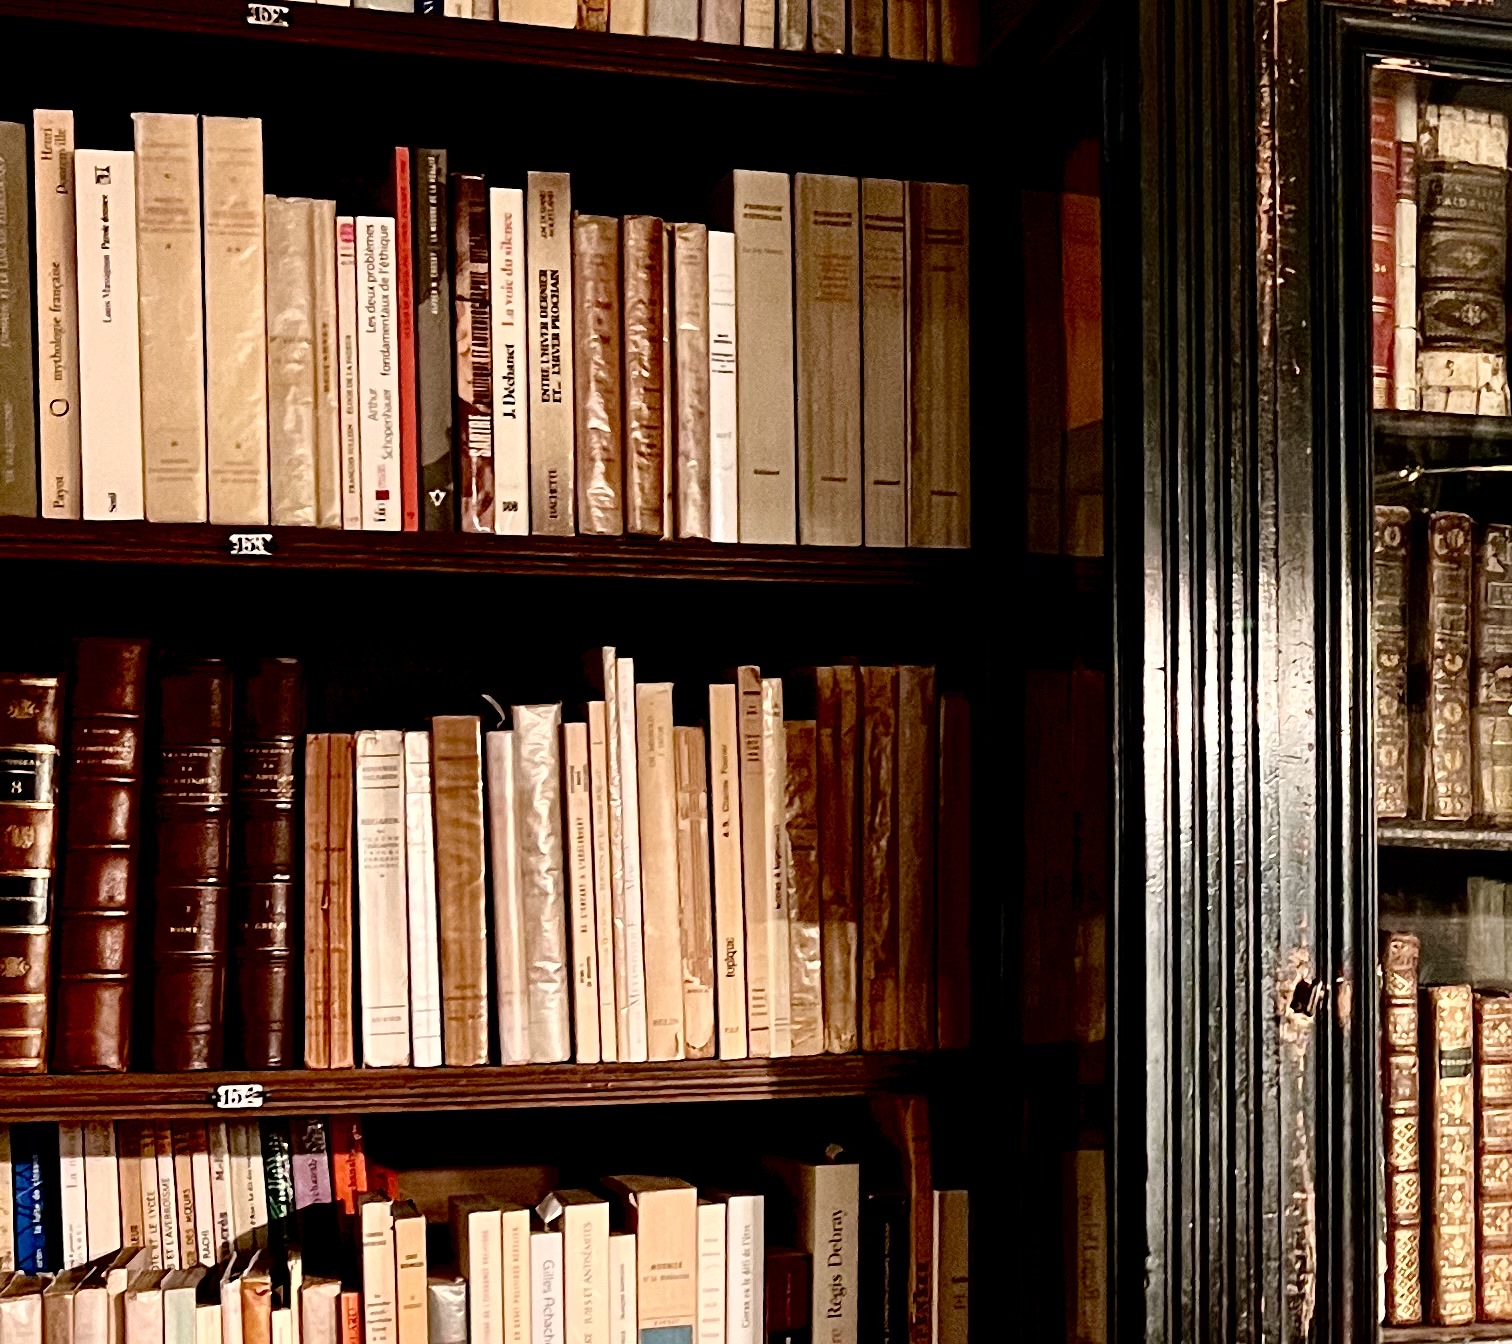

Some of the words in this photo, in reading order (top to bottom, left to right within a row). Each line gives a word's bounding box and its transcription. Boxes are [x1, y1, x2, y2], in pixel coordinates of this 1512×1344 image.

[40, 128, 53, 161] Henri
[379, 224, 392, 275] l'éthique
[500, 212, 513, 257] silence
[364, 224, 378, 283] problèmes
[500, 259, 513, 277] du
[49, 261, 62, 313] française
[365, 286, 377, 313] deux
[379, 276, 391, 292] de
[501, 279, 513, 306] voie
[550, 269, 560, 330] PROCHAIN
[365, 314, 377, 334] Les
[379, 293, 391, 376] fondamentaux
[501, 308, 514, 326] La
[50, 316, 63, 382] mythologie
[502, 345, 516, 406] Déchanet
[540, 367, 549, 403] ENTRE
[366, 388, 379, 422] Arthur
[502, 408, 516, 420] J.
[381, 389, 393, 460] Schopenhauer
[53, 475, 66, 510] Payot
[201, 1229, 212, 1260] RACHI
[582, 1222, 593, 1284] ANTISÉMITES
[825, 1209, 847, 1268] Debray
[542, 1259, 555, 1294] Gilles
[741, 1259, 750, 1276] défi
[582, 1288, 593, 1298] ET
[825, 1274, 846, 1319] Régis
